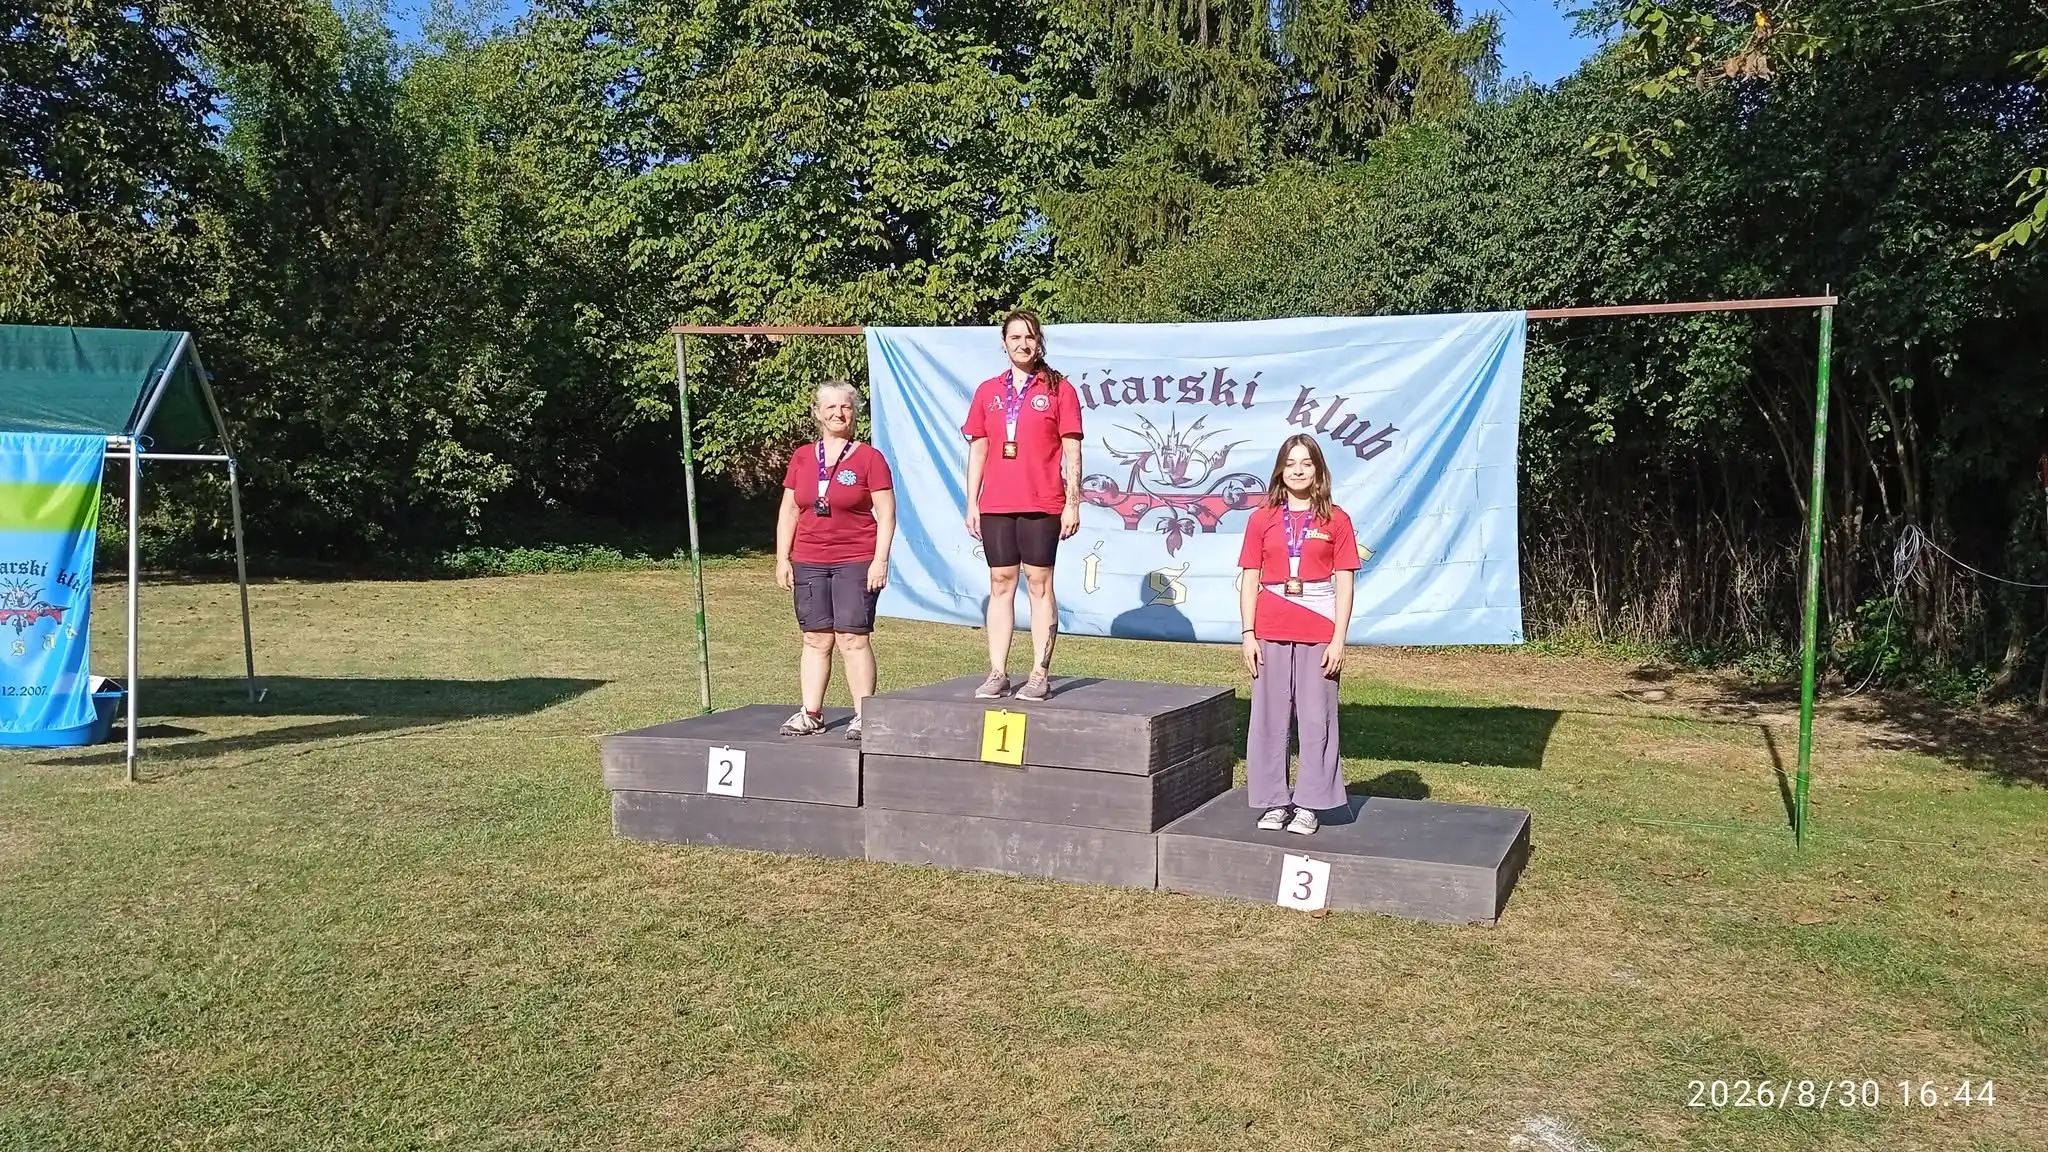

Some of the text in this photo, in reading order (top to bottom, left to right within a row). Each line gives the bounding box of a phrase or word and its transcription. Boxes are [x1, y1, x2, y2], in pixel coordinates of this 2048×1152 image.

[1080, 367, 1400, 461] ičarski klub
[0, 559, 48, 577] arski
[2, 685, 48, 696] 12.2007.
[996, 724, 1010, 753] 1
[718, 759, 733, 787] 2
[1292, 870, 1313, 901] 3
